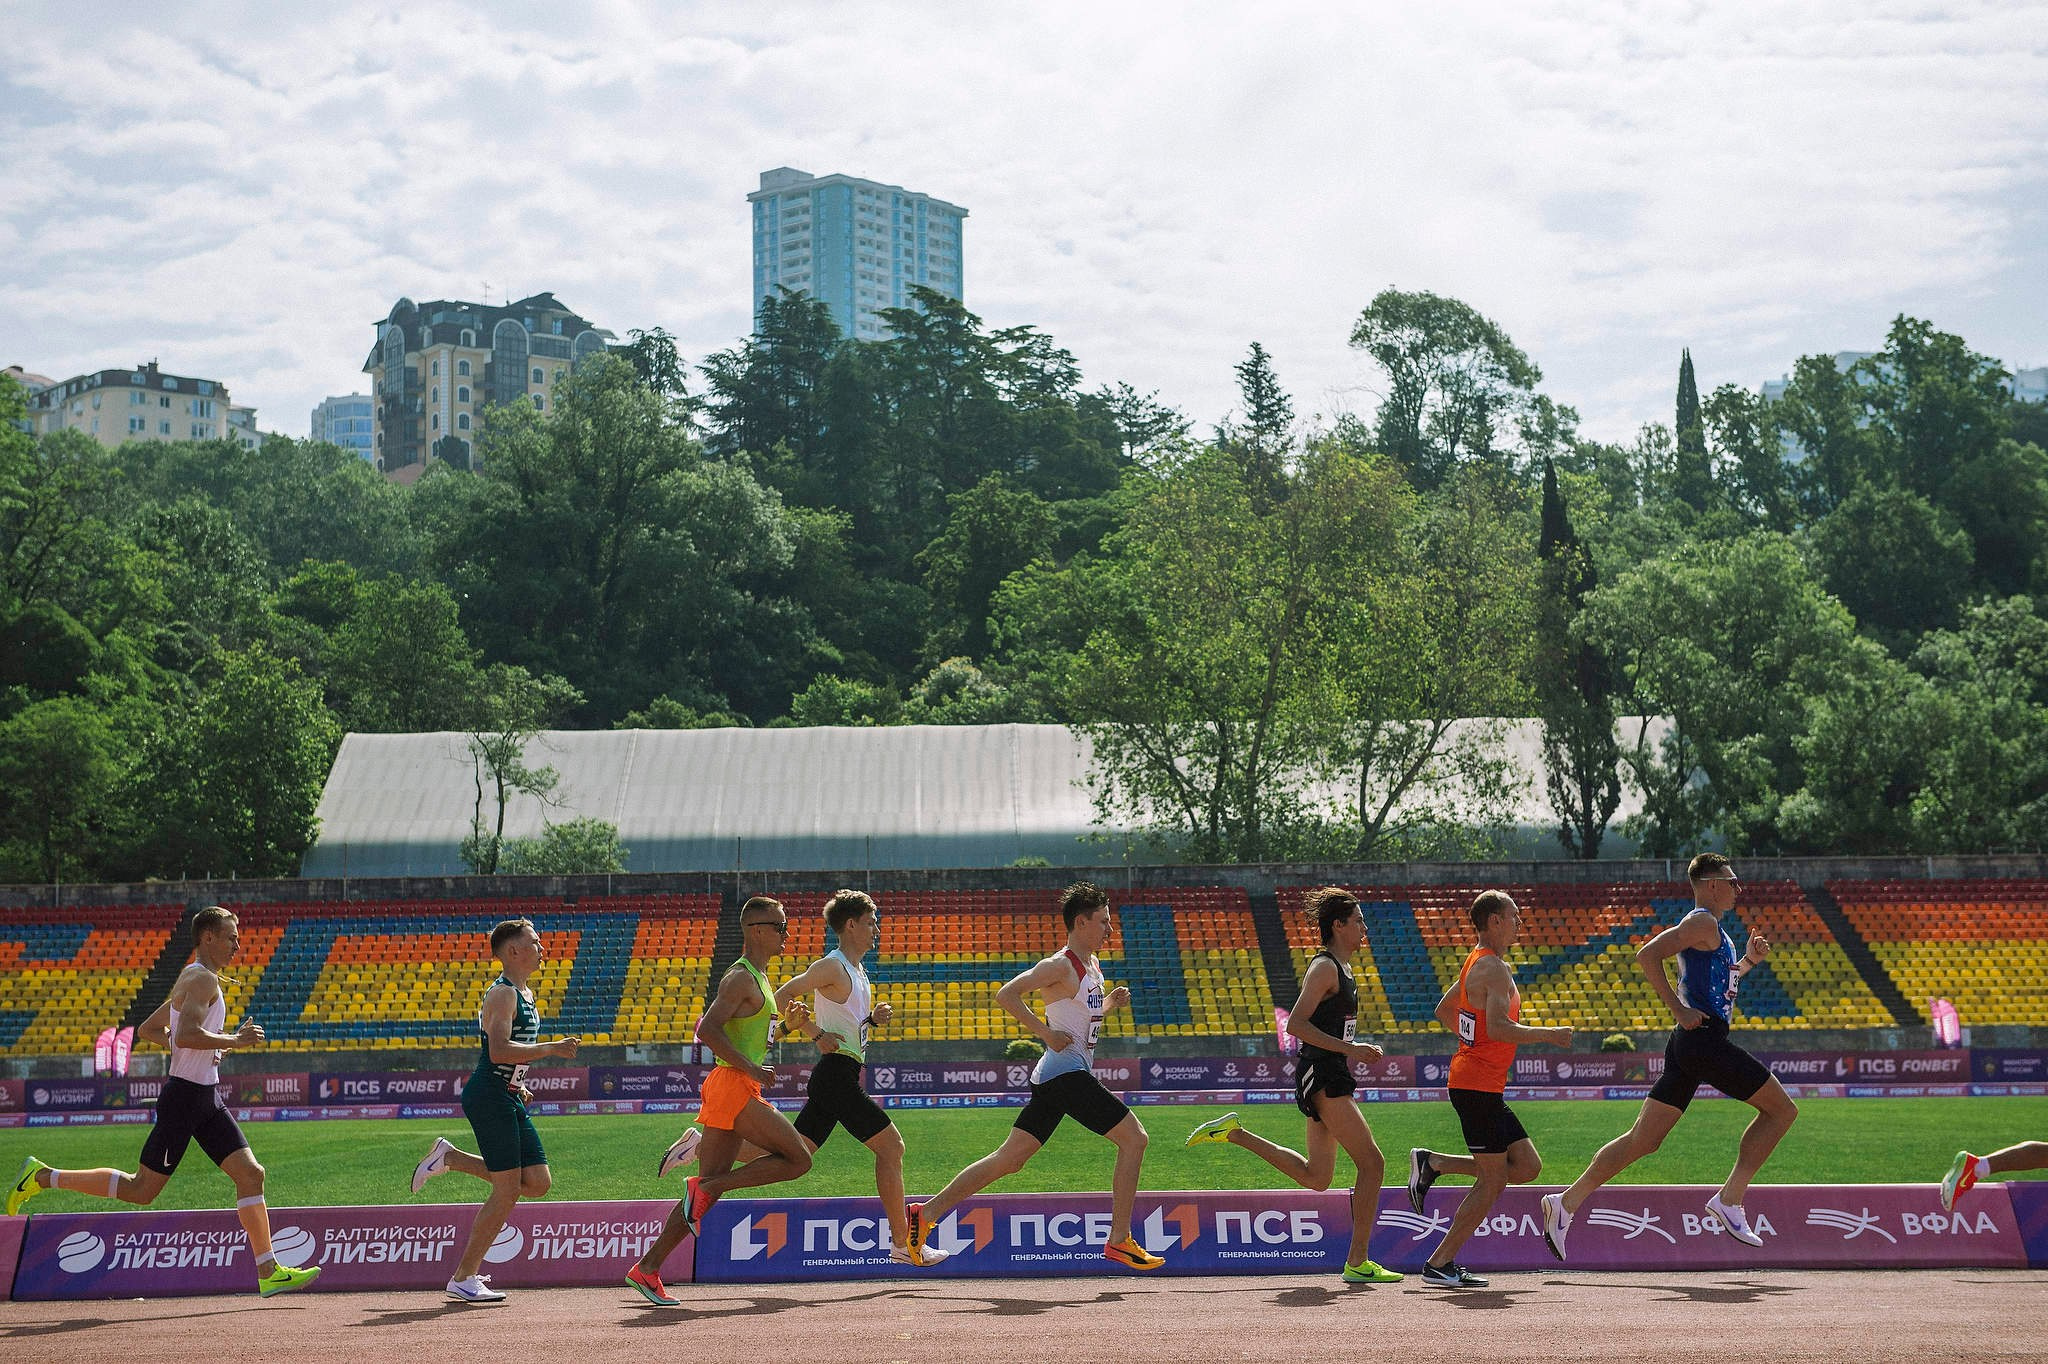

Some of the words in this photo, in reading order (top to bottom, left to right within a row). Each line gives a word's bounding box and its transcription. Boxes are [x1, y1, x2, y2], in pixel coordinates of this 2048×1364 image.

[1165, 1066, 1209, 1074] КОМАНДА
[1516, 1059, 1549, 1074] URAL
[1649, 1058, 1664, 1072] UR
[1770, 1060, 1828, 1073] FONBET
[1859, 1059, 1896, 1073] ПСБ
[1902, 1058, 1961, 1072] FONBET
[901, 1072, 933, 1082] zetta
[1516, 1074, 1550, 1083] LOGISTICS
[1573, 1068, 1616, 1078] ЛИЗИНГ
[266, 1078, 300, 1093] URAL
[343, 1080, 380, 1094] ПСБ
[386, 1080, 446, 1093] FONBET
[665, 1084, 692, 1093] ВФЛА
[50, 1093, 95, 1104] ЛИЗИНГ
[645, 1103, 681, 1111] FONBET
[532, 1220, 662, 1236] БАЛТИЙСКИЙ
[1010, 1213, 1113, 1247] ПСБ
[1215, 1210, 1324, 1244] ПСБ
[1474, 1213, 1545, 1237] ВФЛ
[1681, 1213, 1778, 1236] ВФА
[1901, 1211, 1999, 1235] ВФЛА
[114, 1230, 248, 1246] БАЛТИЙСКИЙ
[324, 1224, 456, 1241] БАЛТИЙСКИЙ
[107, 1245, 245, 1270] ЛИЗИНГ
[319, 1240, 455, 1264] ЛИЗИНГ
[1011, 1252, 1073, 1261] ГЕНЕРАЛЬНЫЙ
[1074, 1252, 1106, 1260] СПОНС
[1218, 1250, 1280, 1258] ГЕНЕРАЛЬНЫЙ
[1281, 1250, 1326, 1258] СПОНСОР
[802, 1258, 865, 1266] ГЕНЕРАЛЬНЫЙ
